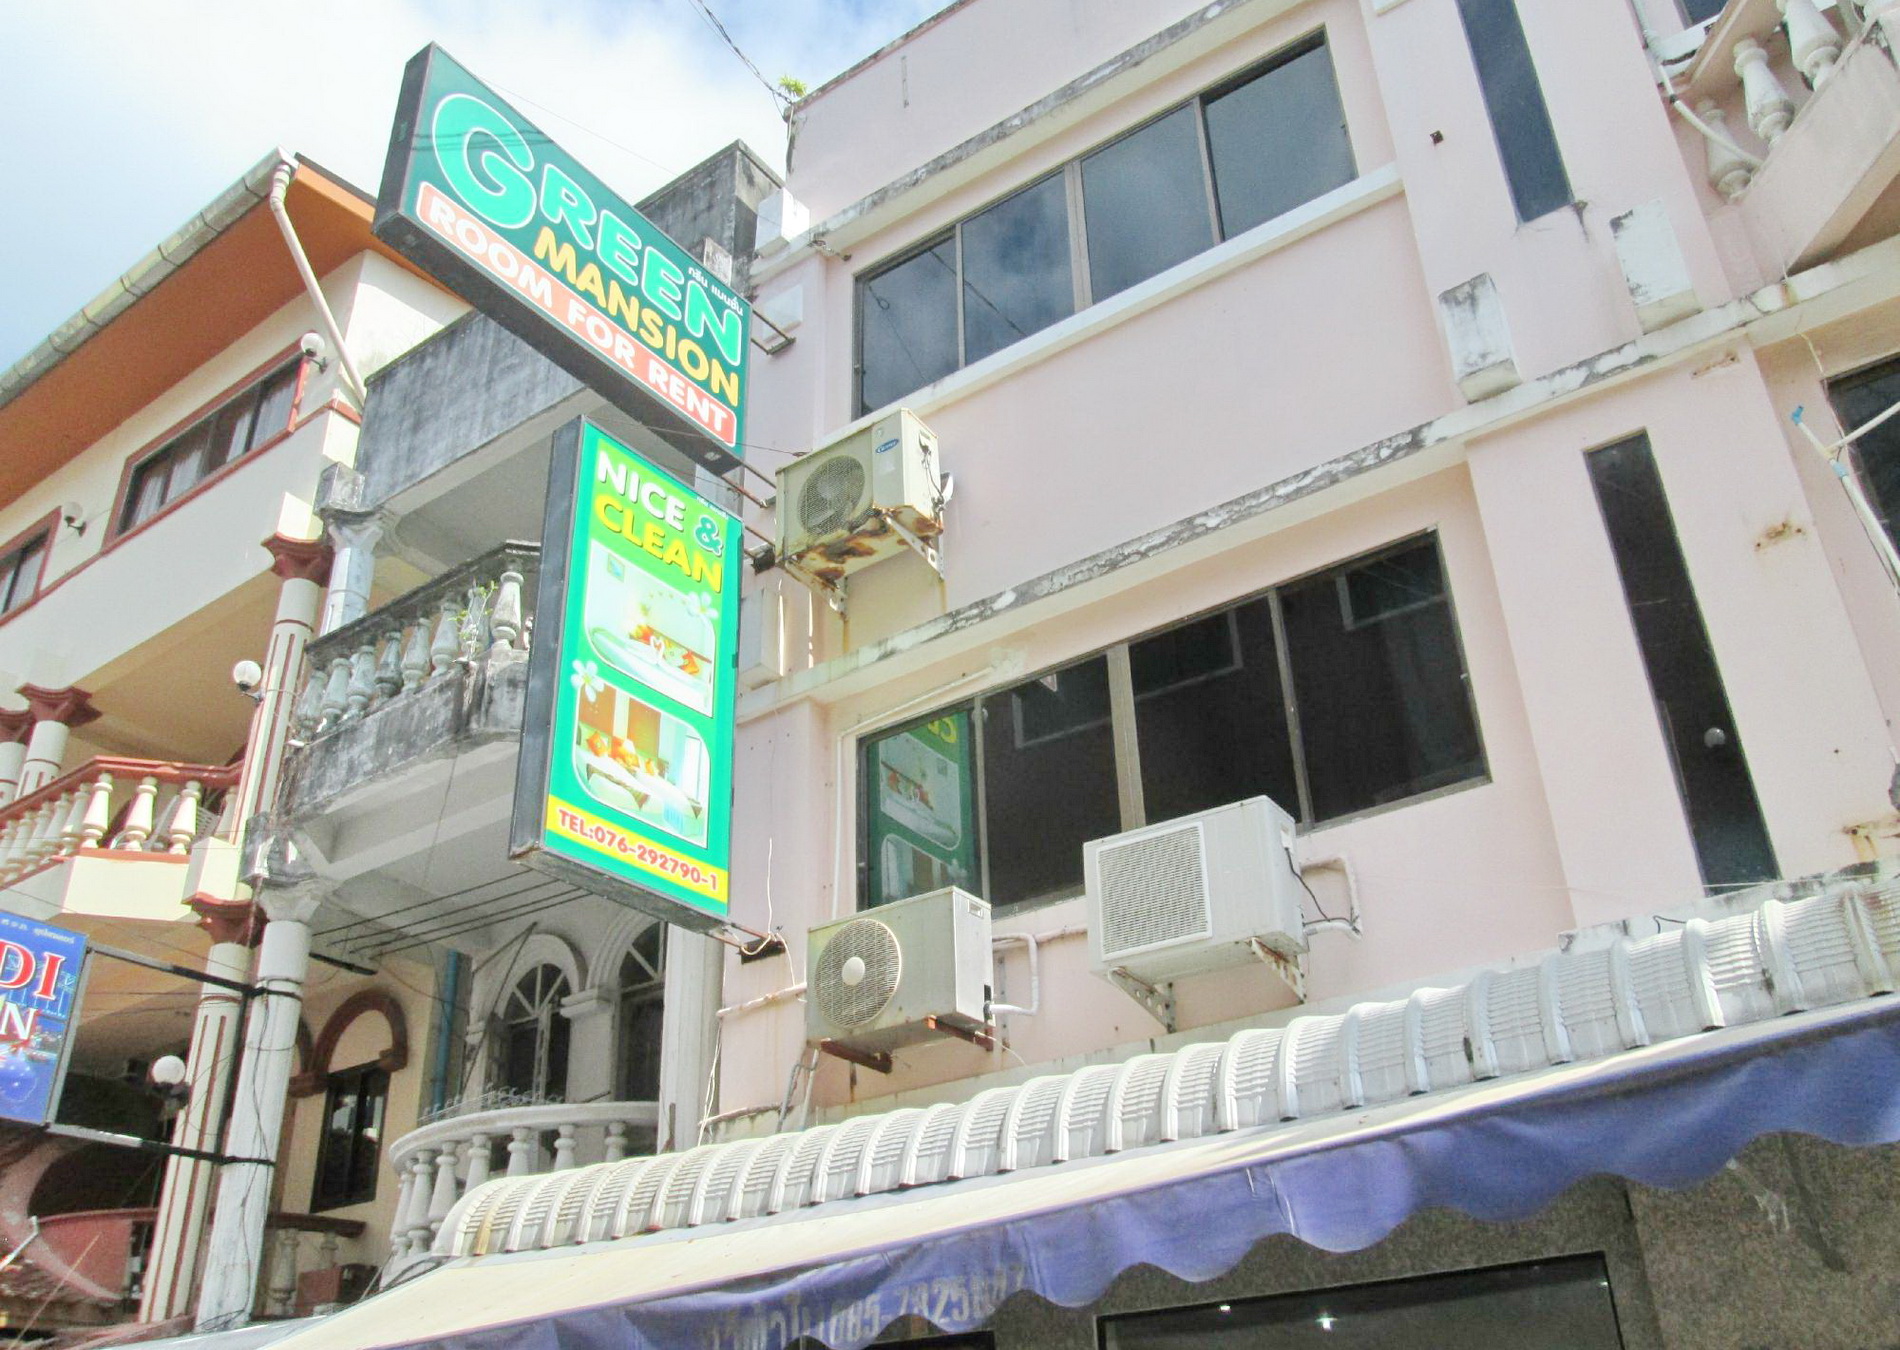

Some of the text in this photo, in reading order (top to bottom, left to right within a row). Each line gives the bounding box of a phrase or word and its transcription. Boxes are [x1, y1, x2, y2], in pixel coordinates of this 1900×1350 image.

[430, 199, 727, 432] ROOM FOR RENT
[432, 93, 742, 367] GREEN
[534, 226, 739, 407] MANSION
[594, 493, 723, 594] CLEAN
[597, 449, 724, 557] NICE &
